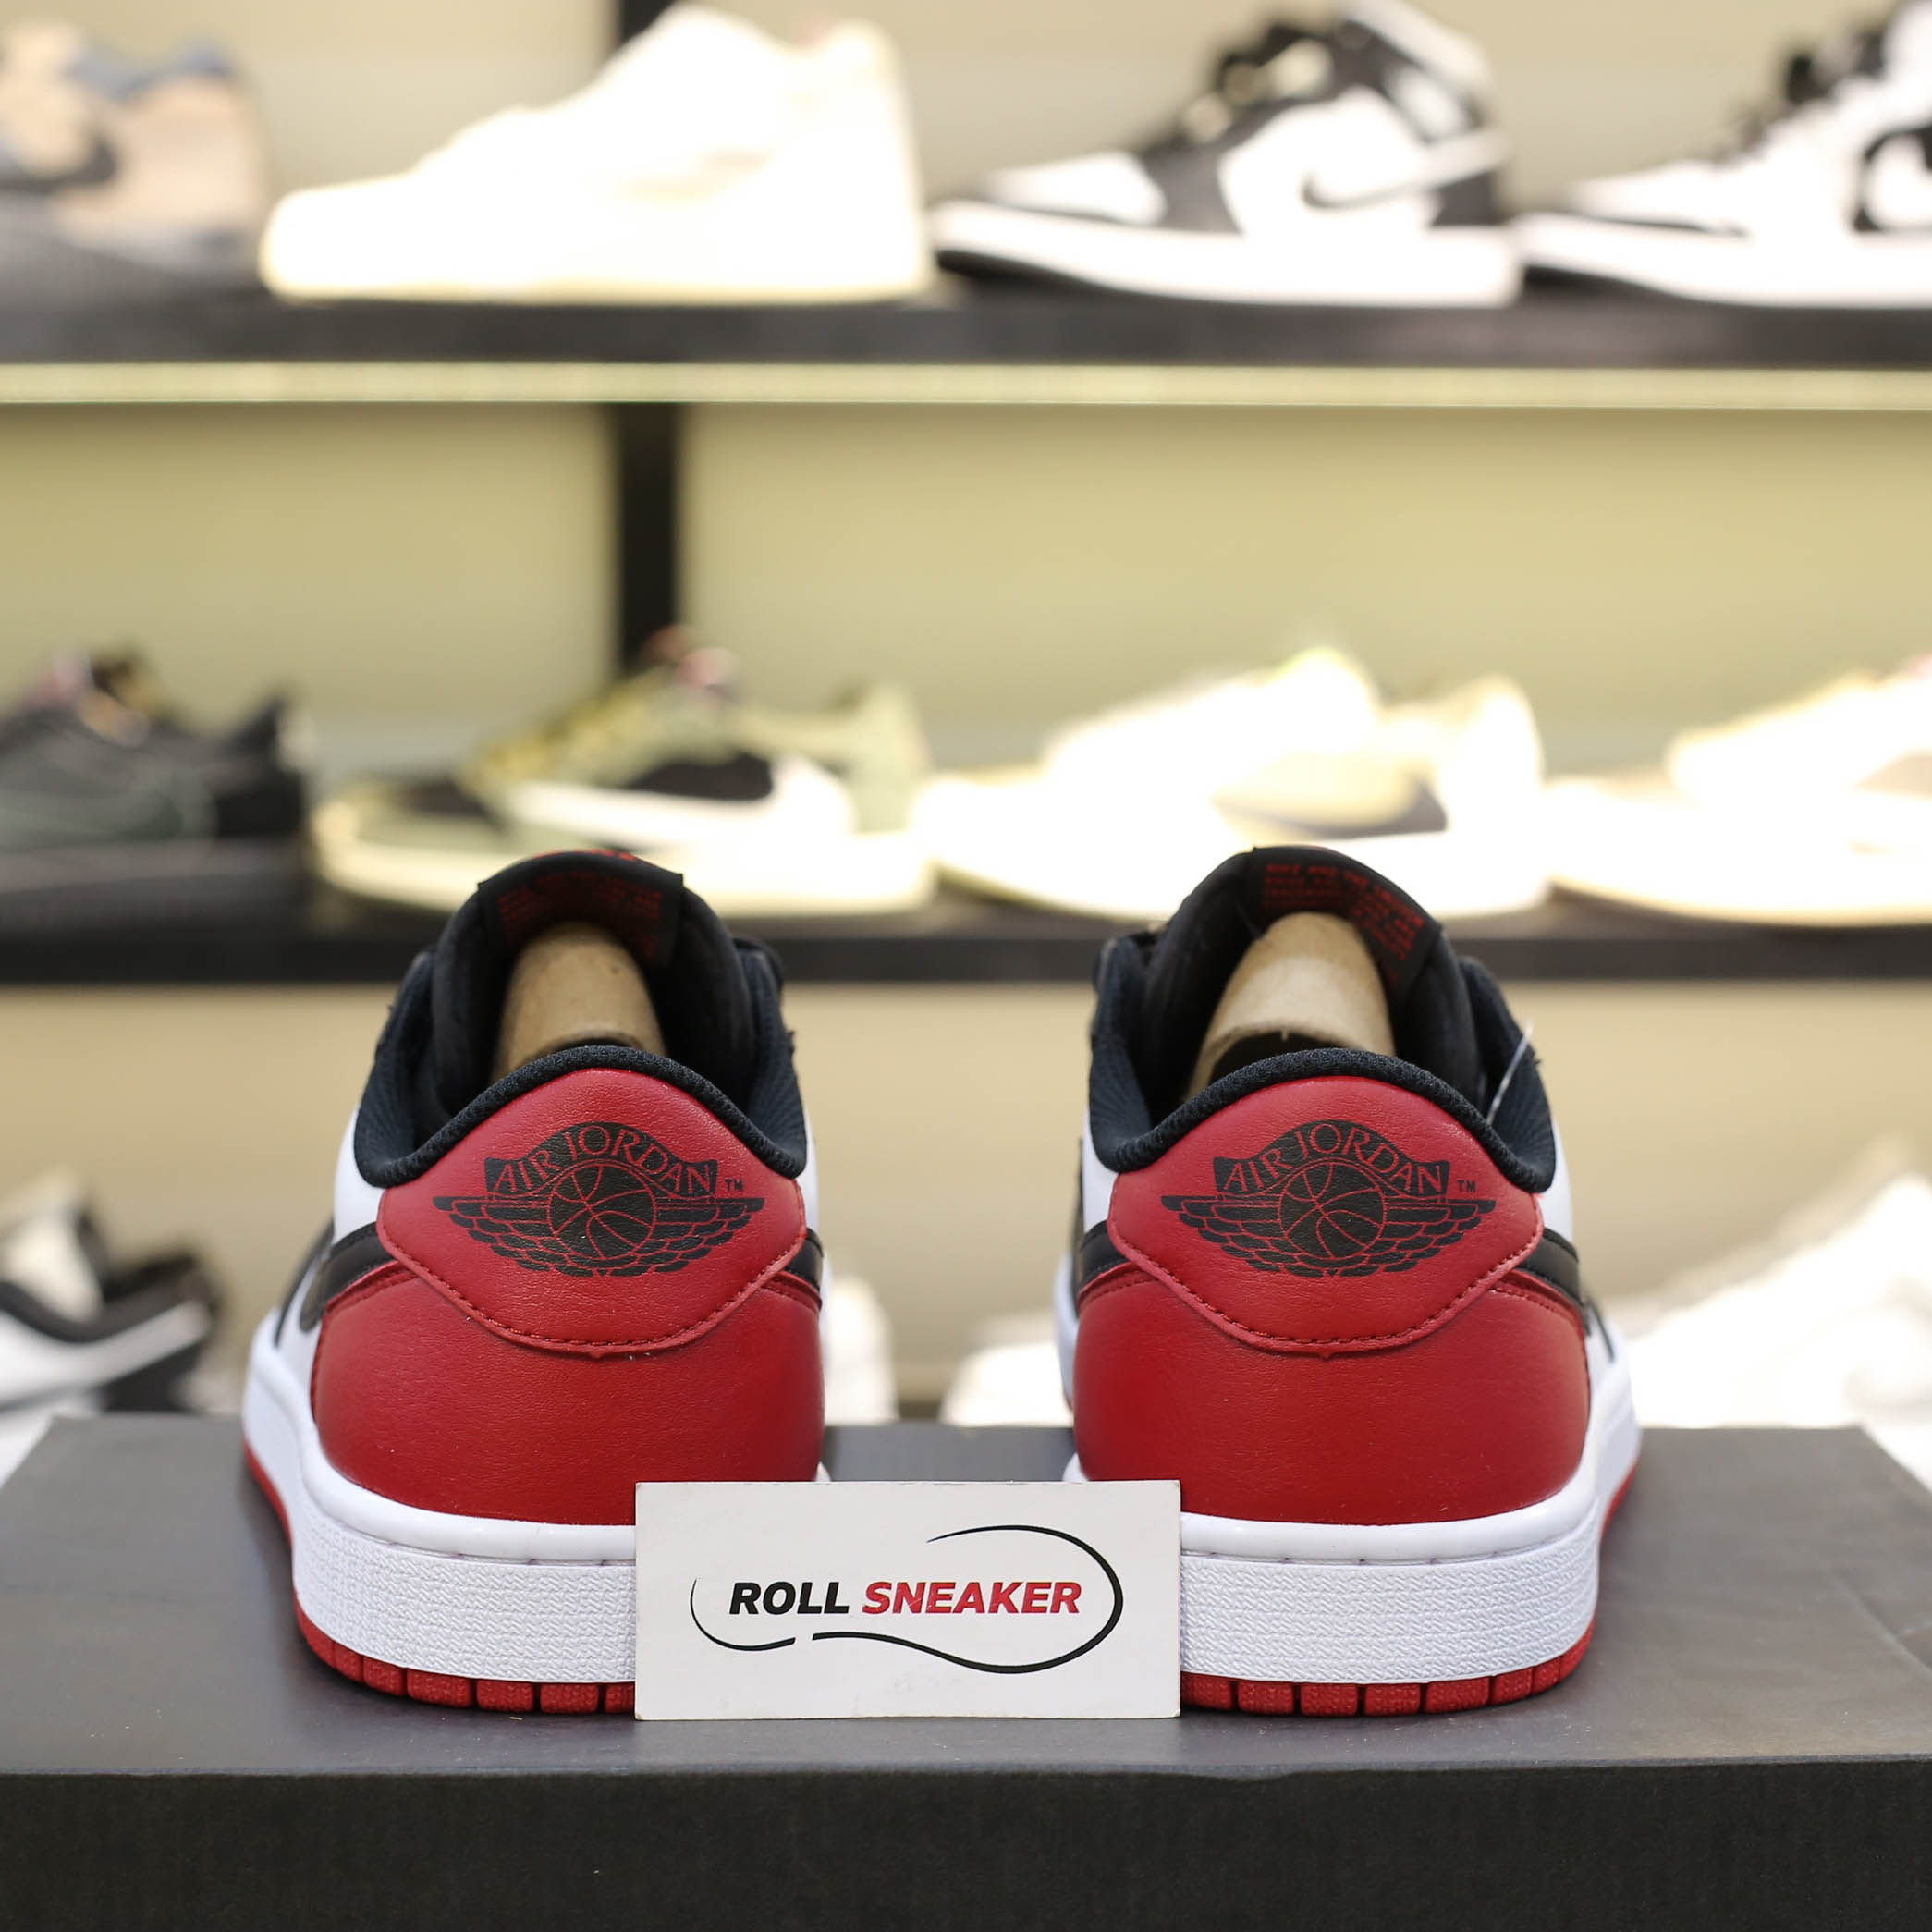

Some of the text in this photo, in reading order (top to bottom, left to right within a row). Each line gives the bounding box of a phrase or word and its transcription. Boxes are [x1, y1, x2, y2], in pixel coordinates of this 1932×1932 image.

[495, 1125, 712, 1194] AIR JORDAN
[1223, 1124, 1442, 1193] AIR JORDAN
[729, 1582, 1082, 1614] ROLL SNEAKER
